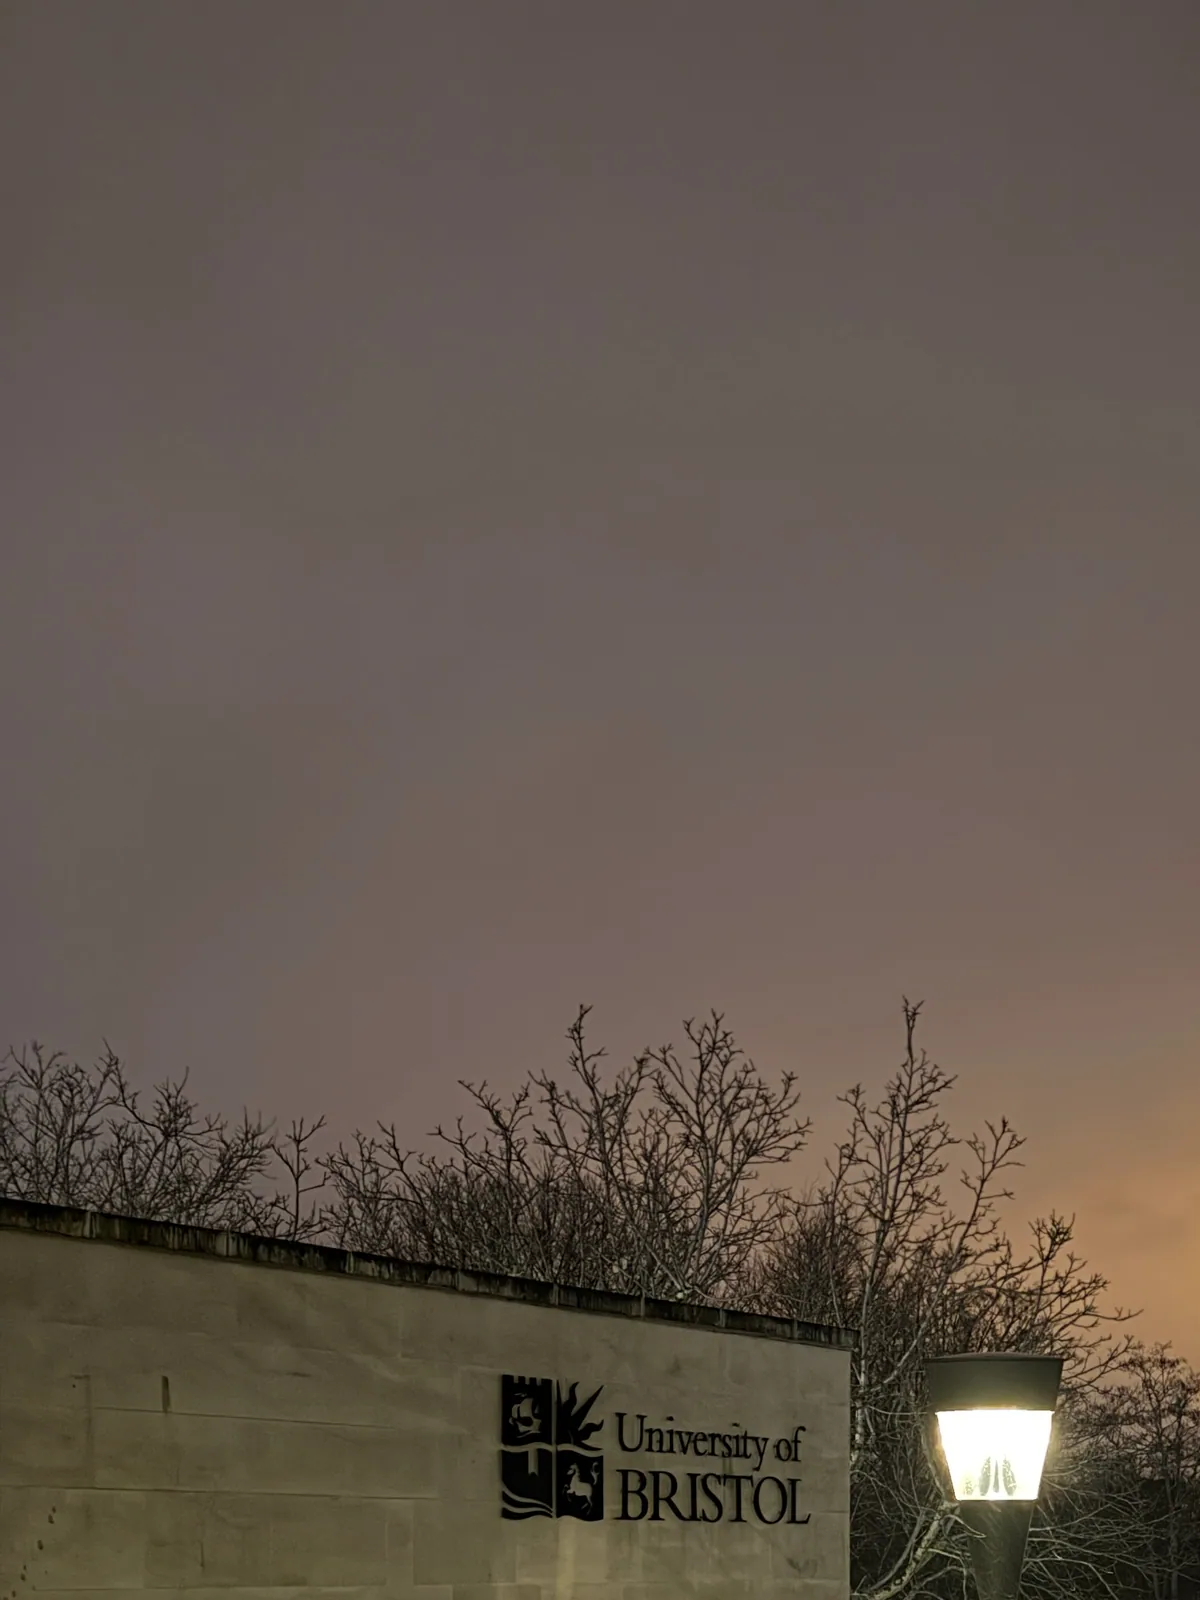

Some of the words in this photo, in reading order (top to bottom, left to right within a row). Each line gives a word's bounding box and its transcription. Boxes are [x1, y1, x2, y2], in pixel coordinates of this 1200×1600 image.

[615, 1412, 769, 1471] University
[773, 1425, 807, 1462] of
[615, 1468, 811, 1525] BRISTOL
